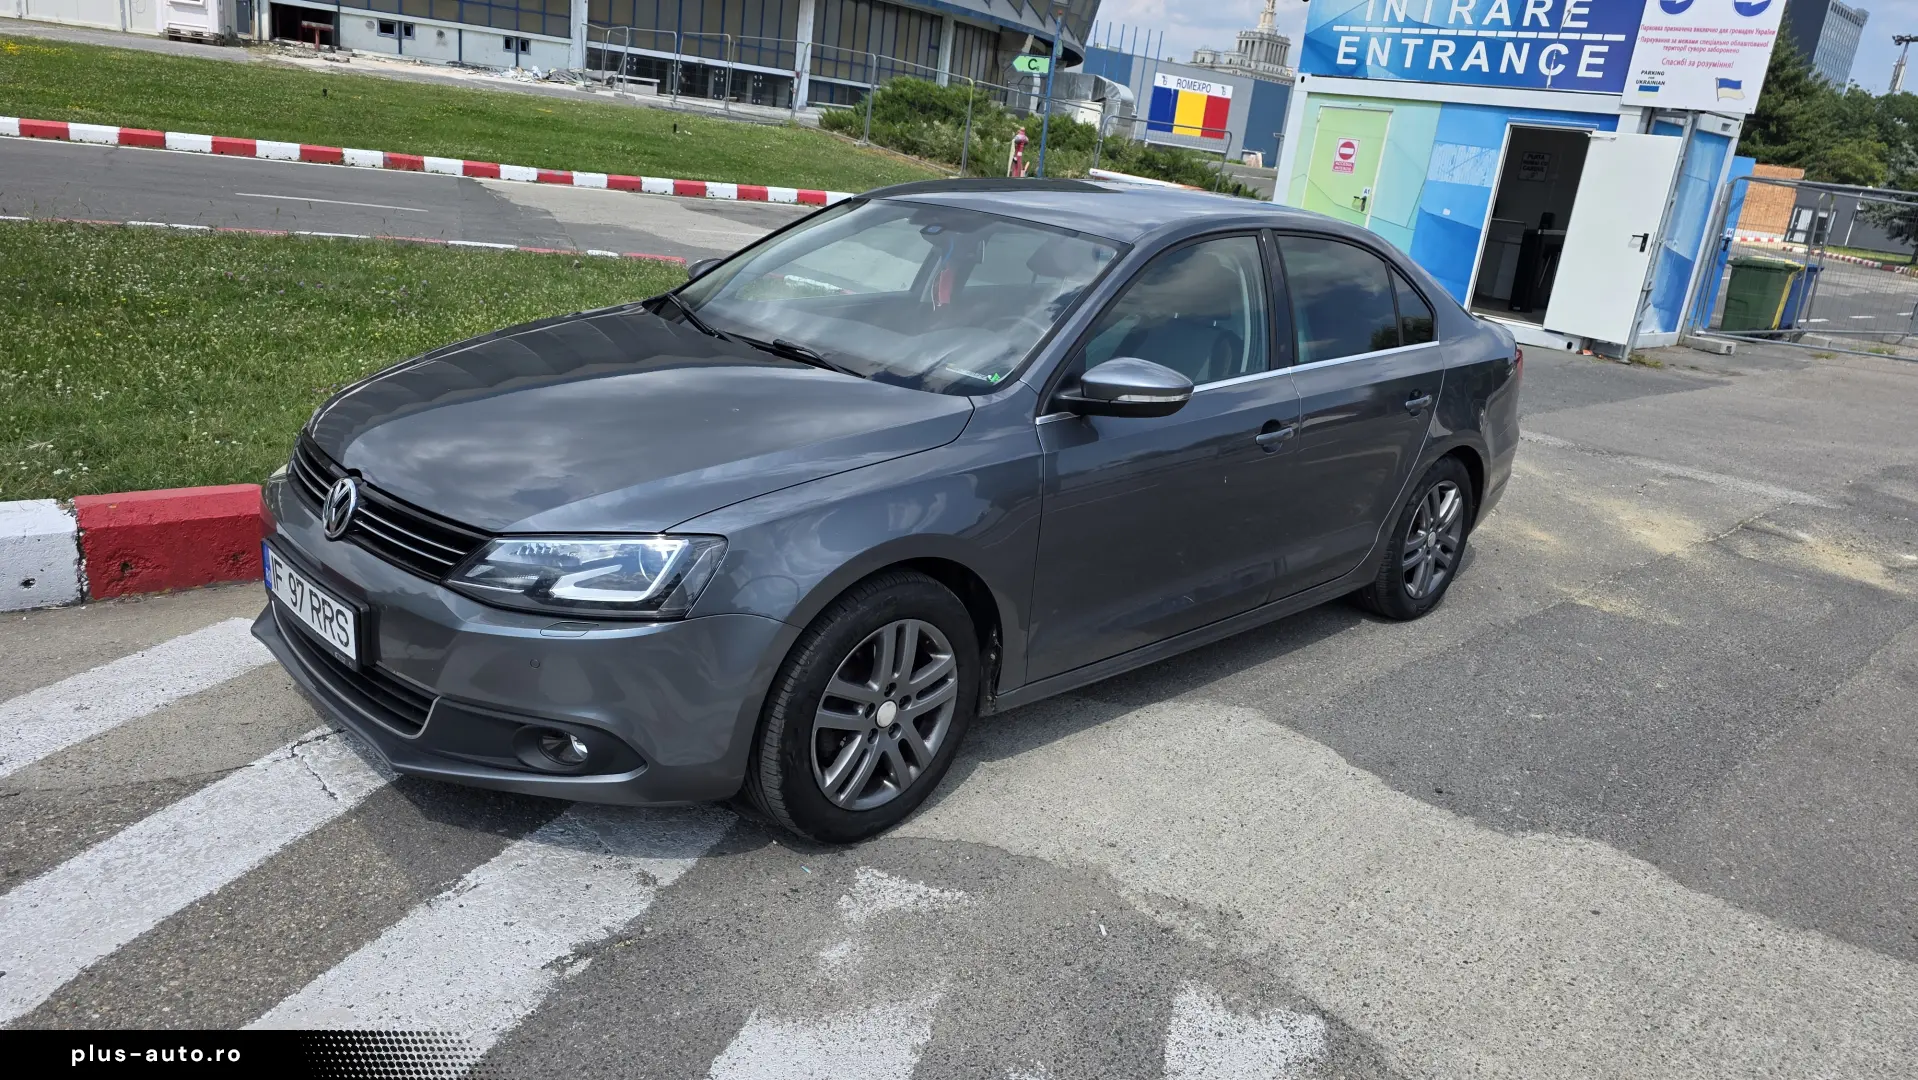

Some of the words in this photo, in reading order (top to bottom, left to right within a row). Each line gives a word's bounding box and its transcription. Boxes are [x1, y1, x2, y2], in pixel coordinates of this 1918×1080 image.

[1365, 0, 1593, 28] INTRARE
[1336, 35, 1610, 78] ENTRANCE
[1661, 57, 1687, 66] Спасибі
[1696, 60, 1735, 69] розуміння!
[1176, 78, 1212, 93] ROMEXPO
[271, 555, 283, 591] IF
[288, 572, 305, 613] 97
[309, 588, 350, 648] RRS
